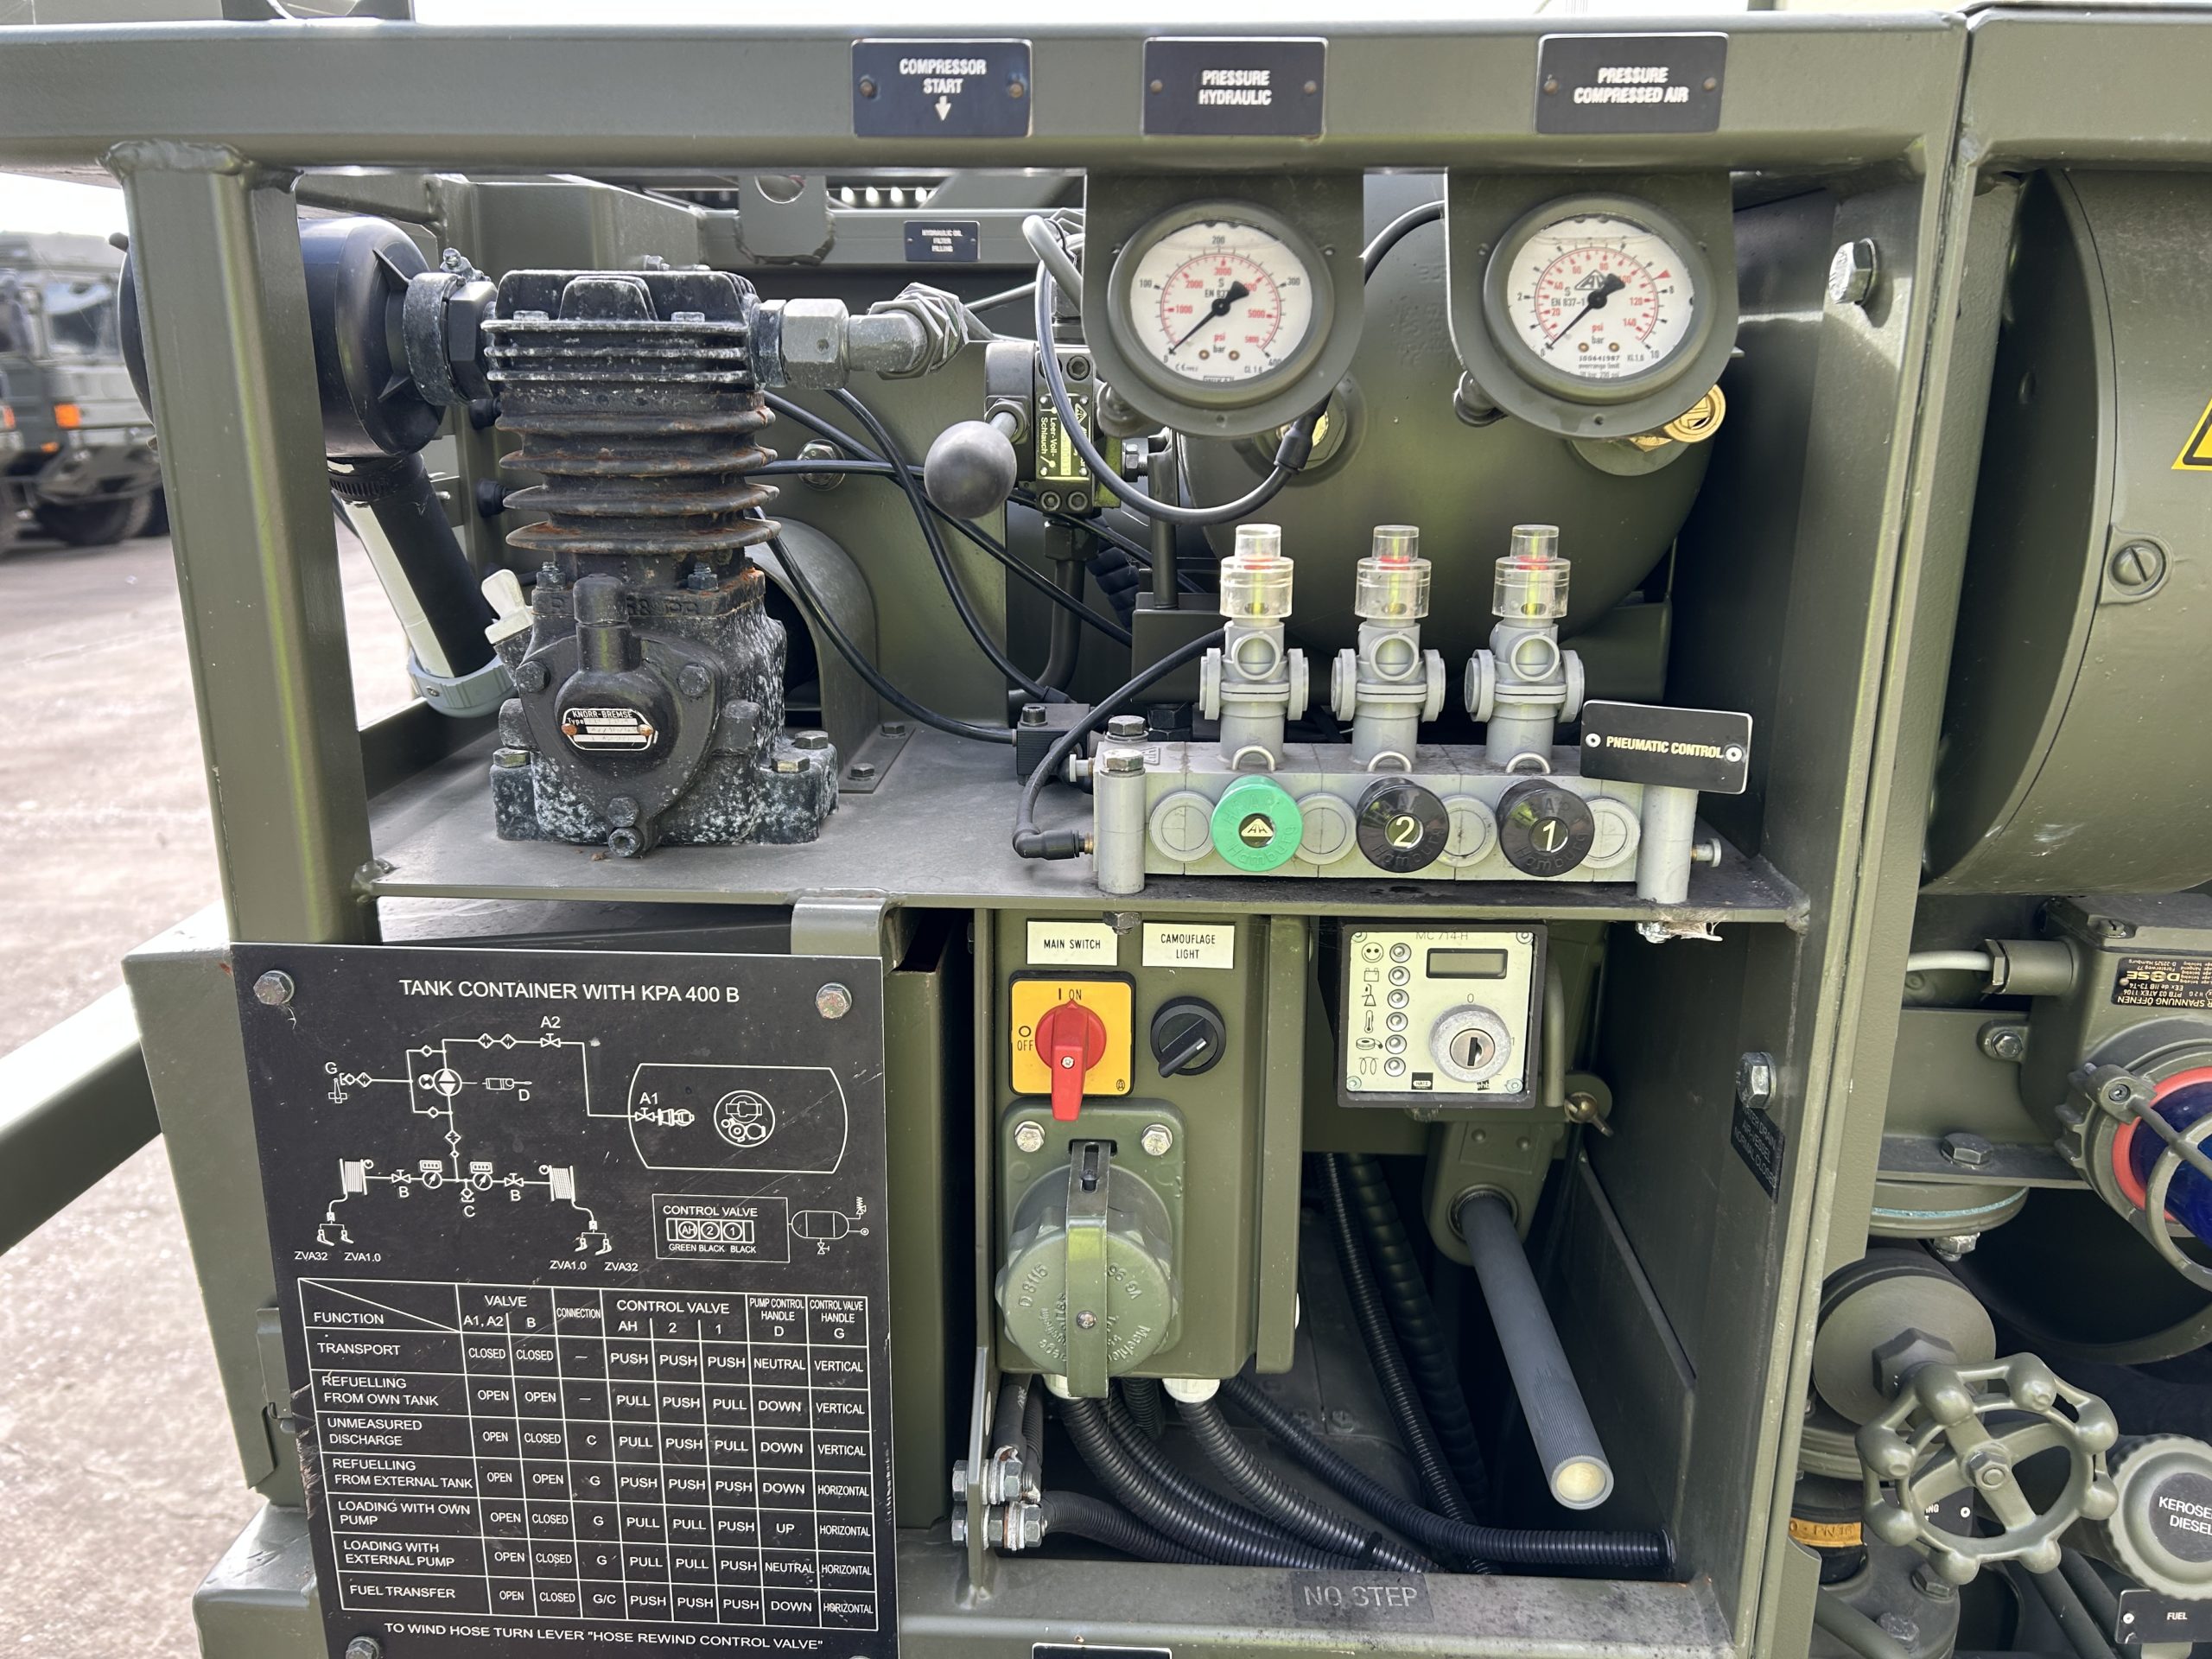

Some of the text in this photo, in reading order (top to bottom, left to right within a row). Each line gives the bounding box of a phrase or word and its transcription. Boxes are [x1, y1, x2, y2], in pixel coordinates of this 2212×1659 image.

[899, 58, 987, 75] COMPRESSOR
[1202, 70, 1270, 86] PRESSURE
[1598, 67, 1669, 83] PRESSURE
[923, 78, 963, 93] START
[1198, 89, 1272, 105] HYDRAULIC
[1573, 86, 1689, 104] COMPRESSED AIR
[1592, 323, 1604, 333] psi
[1214, 333, 1225, 342] psi
[572, 710, 633, 719] KNORR-BREMSE
[1606, 735, 1724, 759] PNEUMATIC CONTROL
[1394, 816, 1414, 847] 2
[1542, 820, 1556, 851] 1
[1044, 939, 1101, 950] MAIN SWITCH
[1160, 934, 1216, 944] CAMOUFLAGE
[1176, 949, 1200, 960] LIGHT
[398, 979, 740, 1003] TANK CONTAINER WITH KPA 400 B
[1069, 989, 1082, 1001] ON
[2118, 995, 2205, 1007] SPANNUNG ÖFFNEN
[540, 1015, 562, 1029] A2
[1017, 1039, 1034, 1052] OFF
[324, 1061, 338, 1075] G
[518, 1088, 531, 1102] D
[639, 1091, 658, 1105] A1
[398, 1185, 410, 1198] B
[510, 1189, 522, 1202] B
[463, 1205, 476, 1218] C
[662, 1205, 759, 1217] CONTROL VALVE
[668, 1243, 757, 1255] GREEN BLACK BLACK
[294, 1250, 328, 1262] ZVA32
[344, 1251, 382, 1262] ZVA1.0
[549, 1260, 588, 1271] ZVA1.0
[604, 1262, 639, 1272] ZVA32
[484, 1294, 528, 1307] VALVE
[616, 1299, 730, 1314] CONTROL VALVE
[749, 1297, 805, 1309] PUMP CONTROL
[809, 1299, 864, 1312] CONTROL VALVE
[314, 1312, 385, 1325] FUNCTION
[556, 1307, 601, 1319] CONNECTION
[760, 1310, 796, 1321] HANDLE
[821, 1312, 855, 1324] HANDLE
[462, 1314, 505, 1328] A1, A2
[526, 1317, 537, 1328] B
[617, 1320, 638, 1332] AH
[668, 1322, 677, 1333] 2
[715, 1324, 721, 1335] 1
[773, 1325, 785, 1337] D
[833, 1327, 845, 1339] G
[316, 1342, 401, 1356] TRANSPORT
[467, 1347, 506, 1360] CLOSED
[515, 1349, 554, 1362] CLOSED
[610, 1352, 649, 1365] PUSH
[659, 1354, 698, 1368] PUSH
[707, 1356, 746, 1369] PUSH
[753, 1357, 806, 1370] NEUTRAL
[813, 1360, 864, 1373] VERTICAL
[322, 1376, 406, 1389] REFUELLING
[323, 1392, 439, 1407] FROM OWN TANK
[477, 1389, 510, 1402] OPEN
[524, 1391, 556, 1403] OPEN
[616, 1395, 652, 1407] PULL
[662, 1396, 701, 1409] PUSH
[712, 1398, 747, 1410] PULL
[758, 1400, 802, 1413] DOWN
[815, 1402, 866, 1414] VERTICAL
[327, 1417, 423, 1431] UNMEASURED
[328, 1433, 404, 1446] DISCHARGE
[482, 1431, 509, 1442] OPEN
[524, 1432, 562, 1445] CLOSED
[586, 1434, 597, 1446] C
[619, 1436, 654, 1448] PULL
[665, 1438, 703, 1450] PUSH
[714, 1439, 749, 1452] PULL
[760, 1441, 804, 1454] DOWN
[817, 1444, 867, 1457] VERTICAL
[332, 1458, 416, 1471] REFUELLING
[334, 1474, 474, 1489] FROM EXTERNAL TANK
[338, 1500, 471, 1515] LOADING WITH OWN
[2158, 1496, 2212, 1519] KEROSE
[340, 1514, 378, 1526] PUMP
[343, 1540, 440, 1554] LOADING WITH
[345, 1553, 455, 1567] EXTERNAL PUMP
[349, 1585, 456, 1599] FUEL TRANSFER
[499, 1590, 524, 1601] OPEN
[539, 1592, 576, 1603] CLOSED
[1304, 1586, 1418, 1607] NO STEP
[593, 1593, 617, 1605] G/C
[771, 1600, 812, 1612] DOWN
[823, 1602, 874, 1614] HORIZONTAL
[2166, 1611, 2188, 1620] FUEL
[384, 1623, 823, 1649] TO WIND HOSE TURN LEVER "HOSE REWIND CONTROL VALVE"
